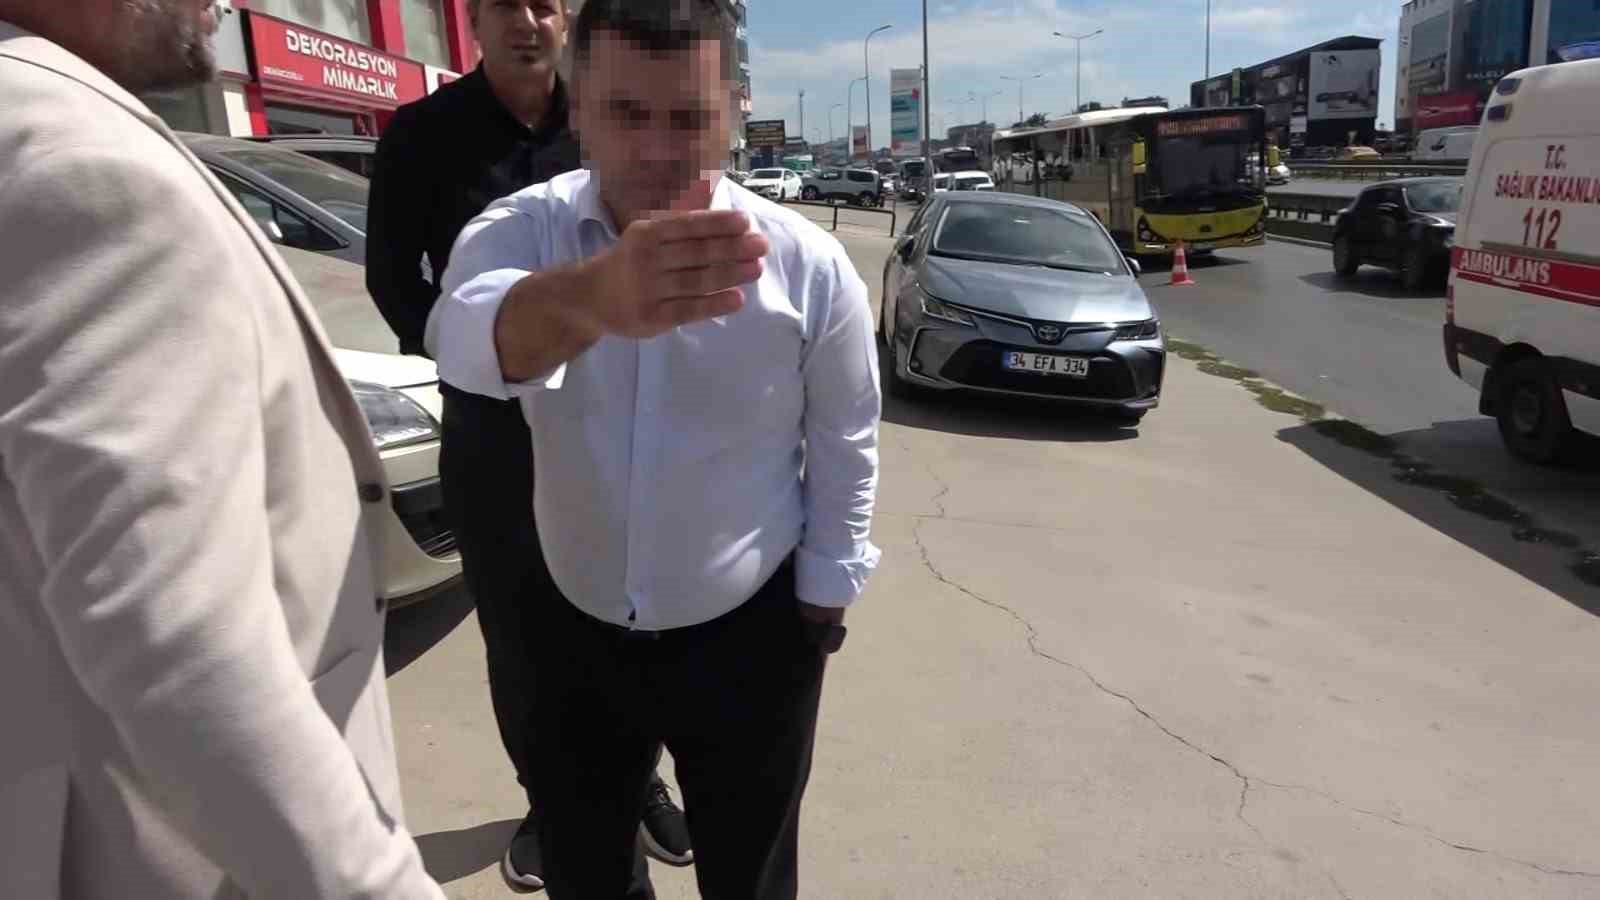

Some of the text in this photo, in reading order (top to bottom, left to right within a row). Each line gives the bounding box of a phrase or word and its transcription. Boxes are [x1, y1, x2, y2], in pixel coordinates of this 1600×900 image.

[285, 28, 397, 78] DEKORASYON
[323, 64, 398, 99] MİMARLIK
[1545, 144, 1566, 169] T.C.
[1495, 170, 1538, 199] SAĞLIK
[1522, 206, 1562, 249] 112
[1459, 250, 1551, 284] AMBULANS
[1009, 352, 1086, 374] 34 EFA 334
